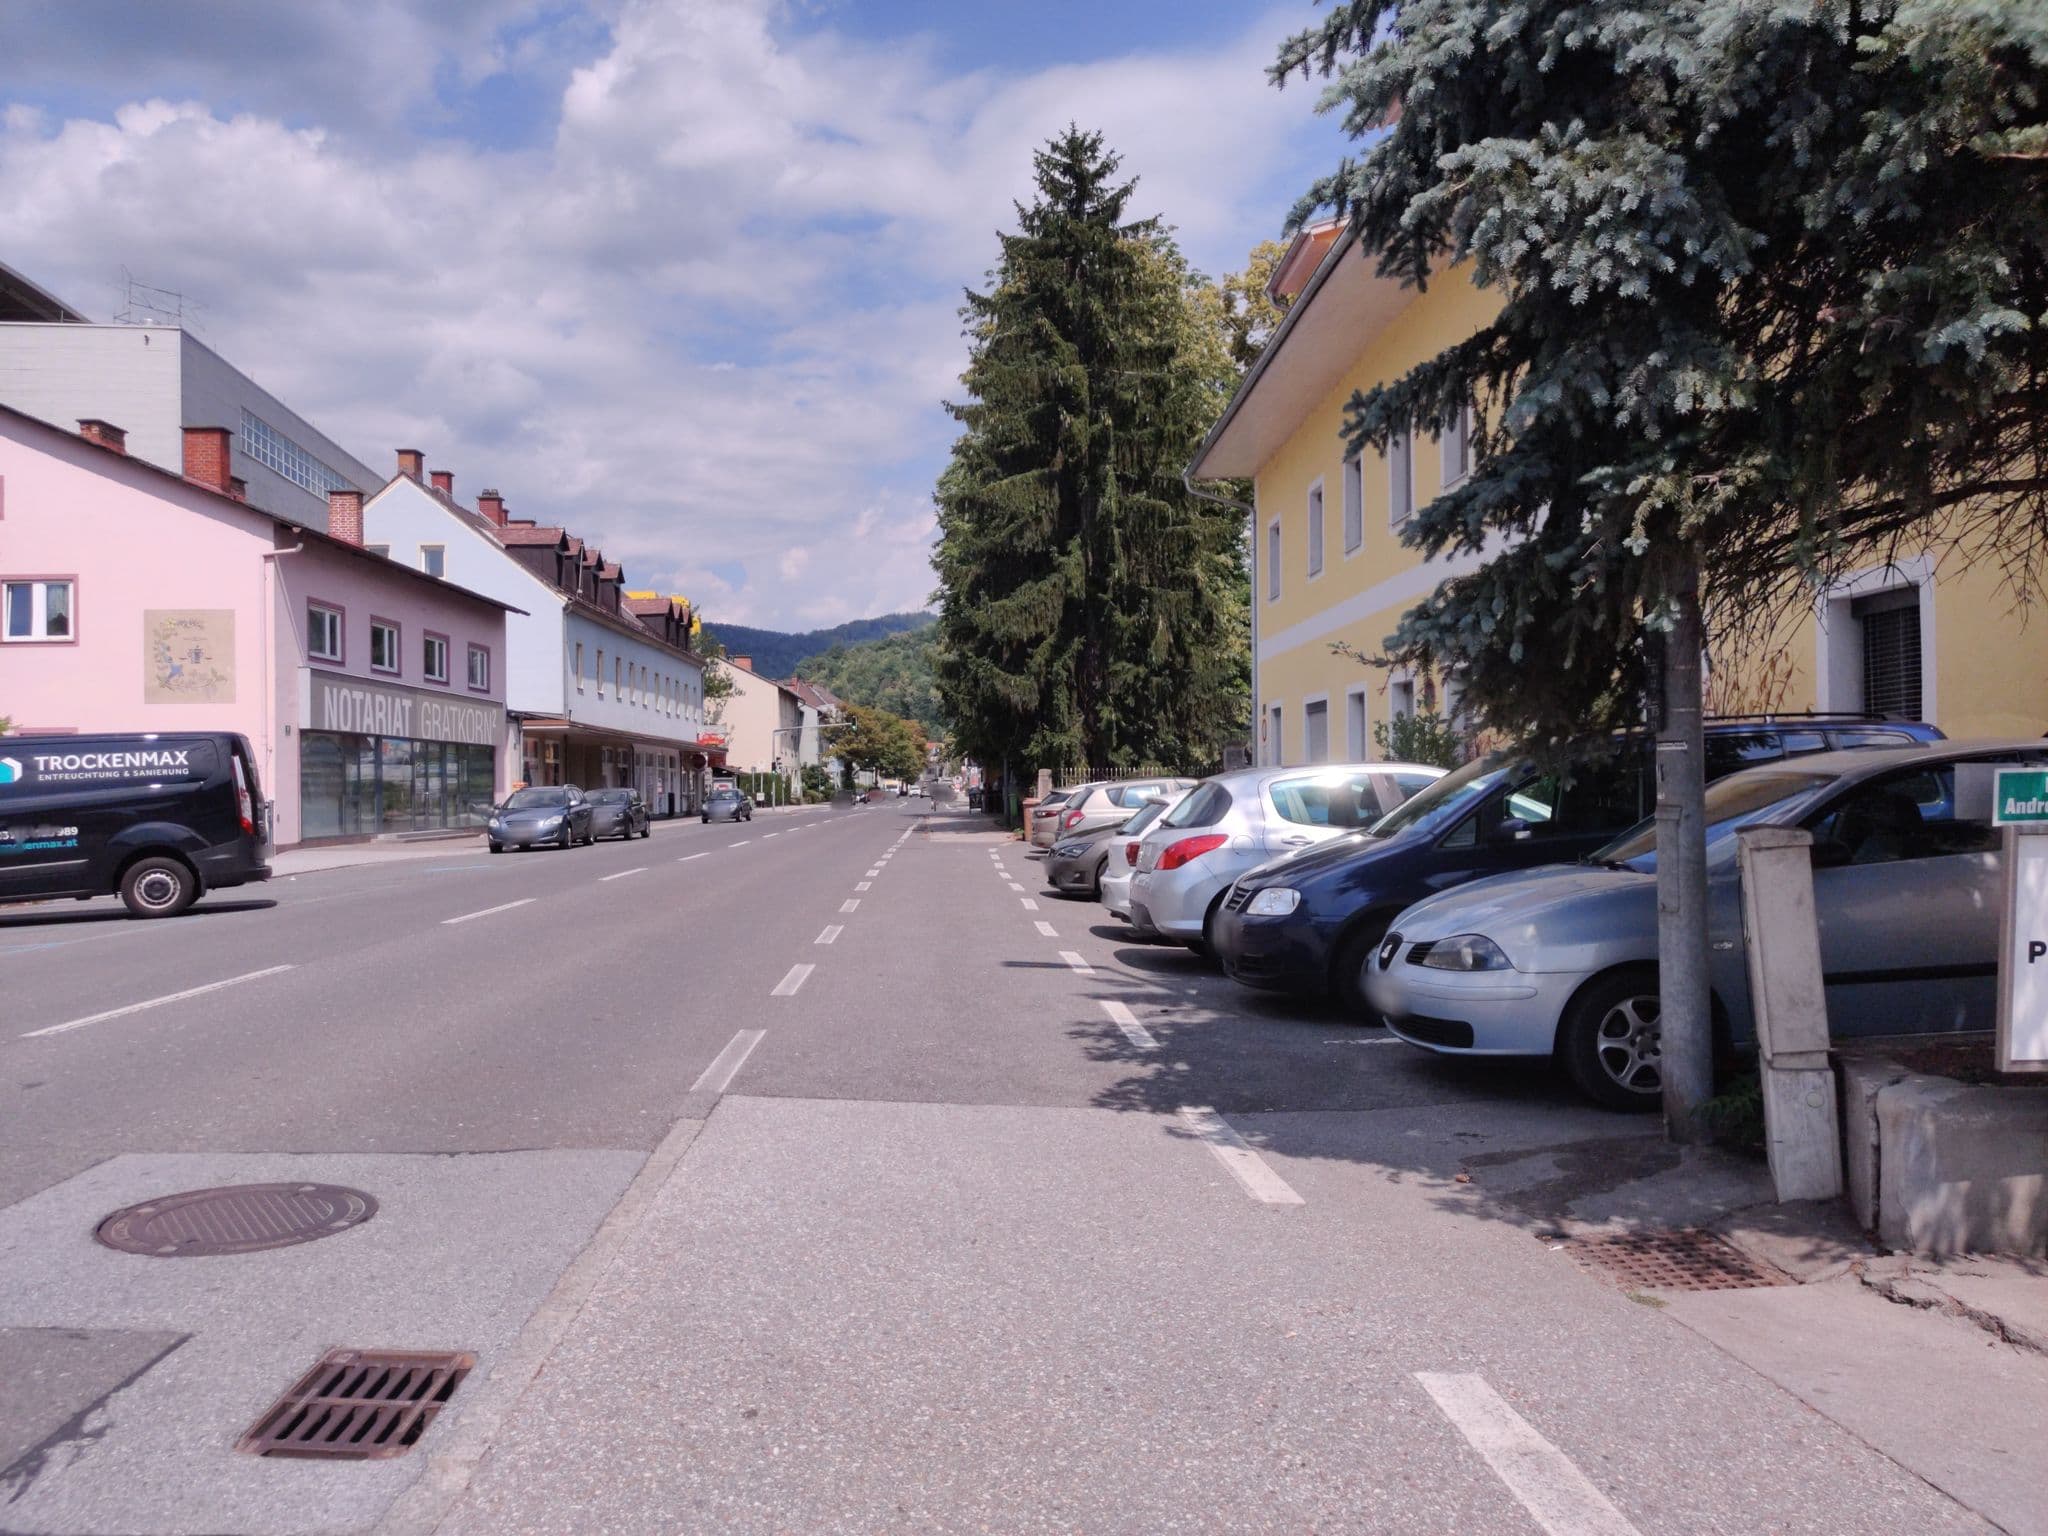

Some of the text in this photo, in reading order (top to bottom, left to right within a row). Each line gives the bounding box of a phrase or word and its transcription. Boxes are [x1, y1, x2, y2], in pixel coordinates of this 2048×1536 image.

[324, 686, 412, 737] NOTARIAT
[34, 751, 189, 771] TROCKENMAX
[38, 771, 121, 781] ENTFEUCHTUNG
[133, 768, 190, 777] SANIERUNG
